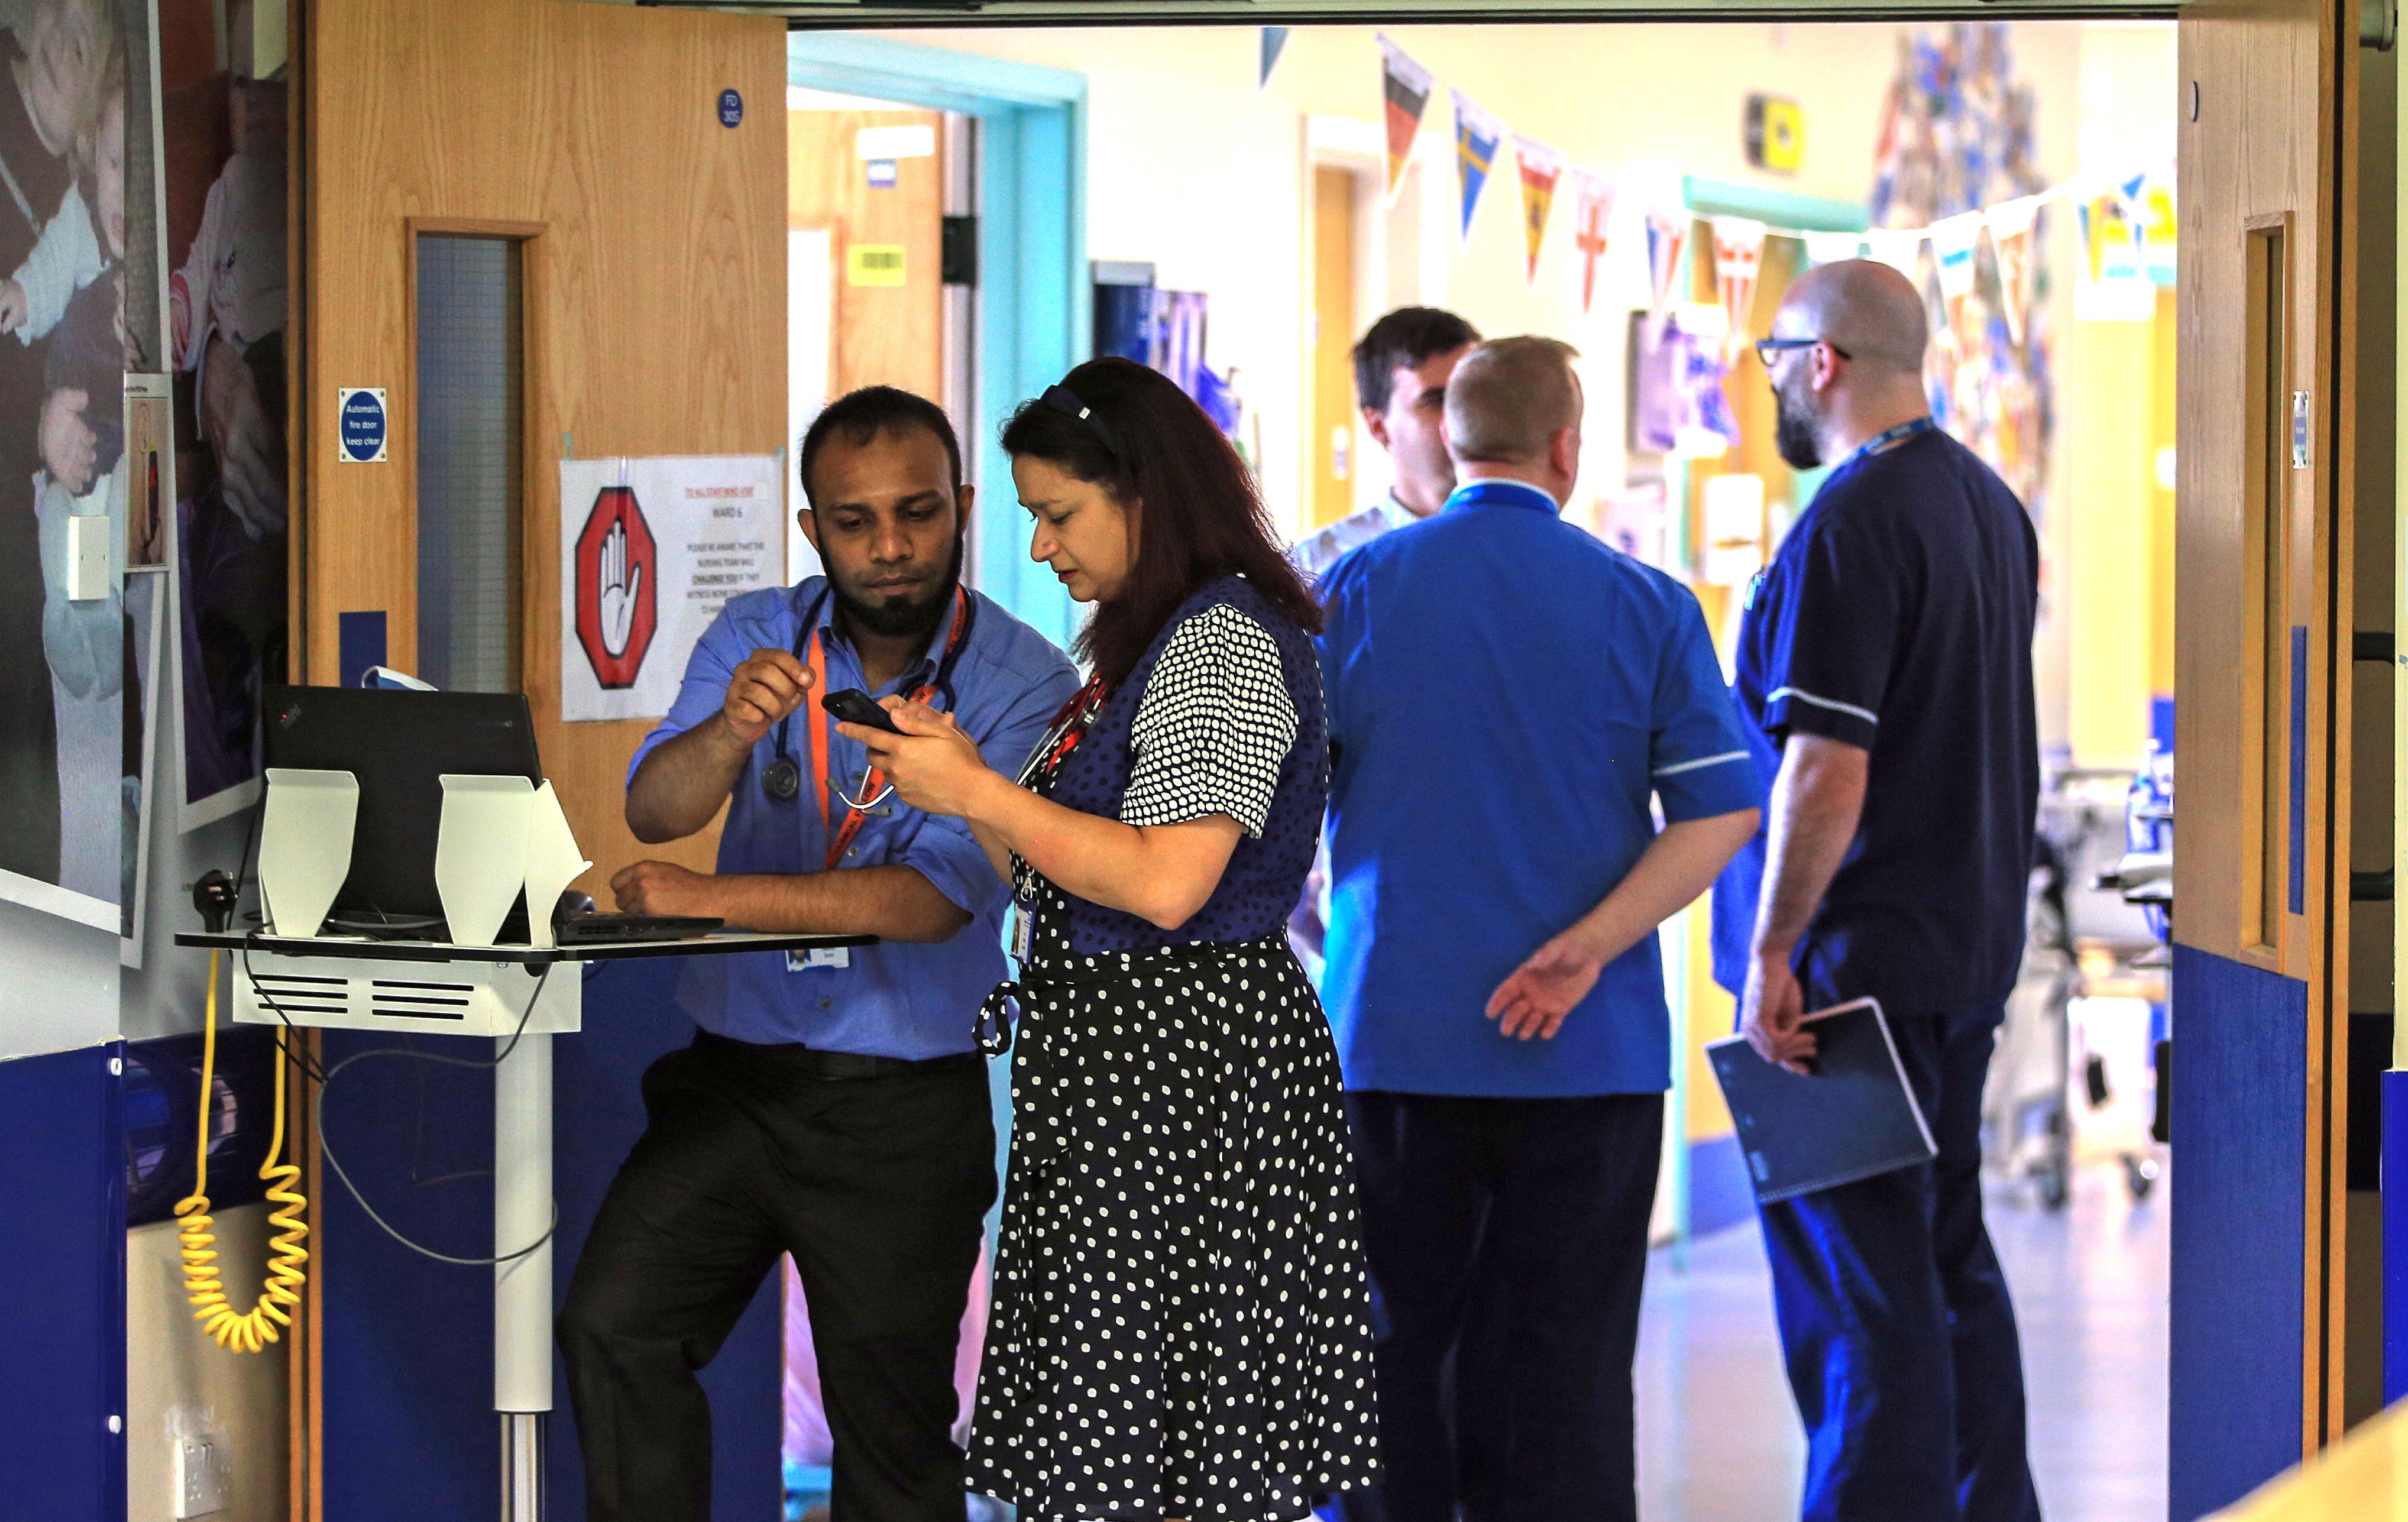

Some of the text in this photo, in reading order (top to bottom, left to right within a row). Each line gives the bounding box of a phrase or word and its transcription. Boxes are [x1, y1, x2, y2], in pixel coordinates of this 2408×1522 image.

[725, 95, 738, 106] FD
[346, 405, 380, 413] Automatic
[349, 420, 377, 429] fire door
[346, 436, 380, 446] keep clear
